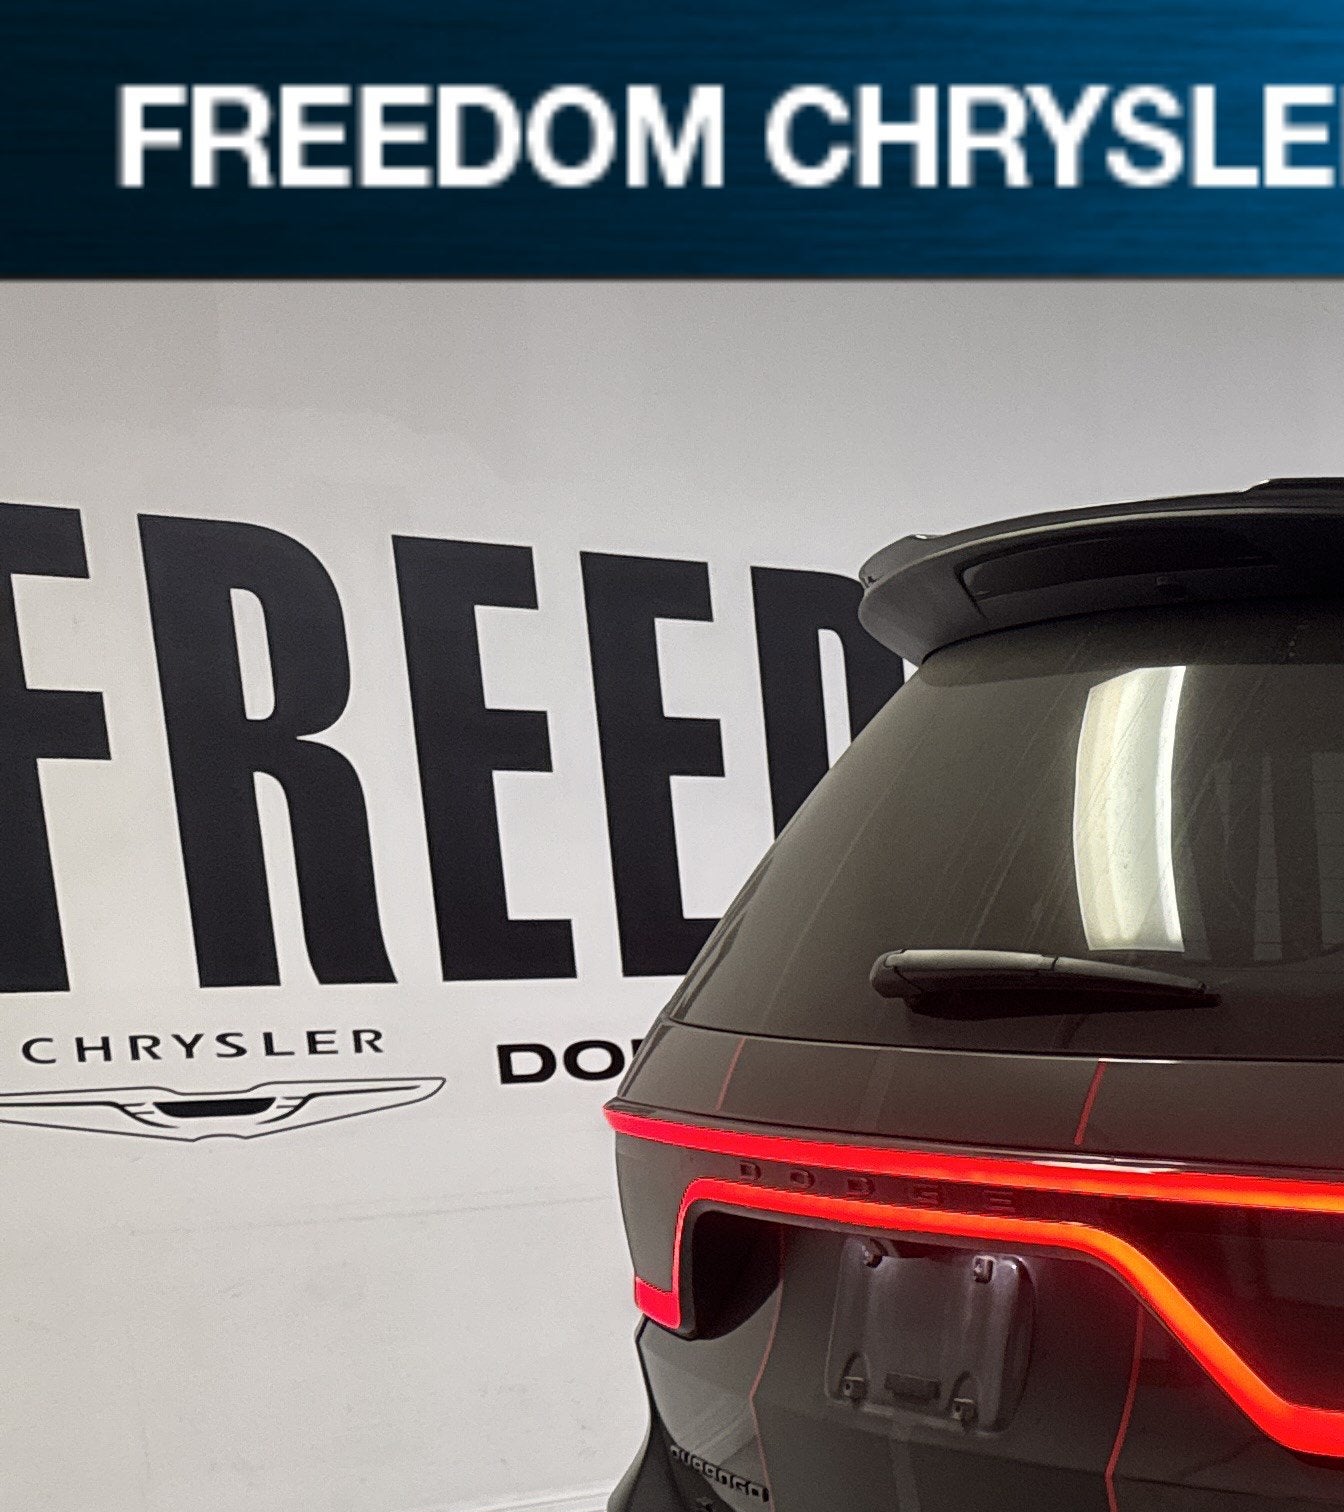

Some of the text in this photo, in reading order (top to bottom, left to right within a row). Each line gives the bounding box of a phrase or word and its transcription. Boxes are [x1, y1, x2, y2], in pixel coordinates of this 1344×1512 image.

[21, 1029, 384, 1065] CHRYSLER
[496, 1038, 646, 1085] DO
[738, 1160, 1016, 1214] DODGE
